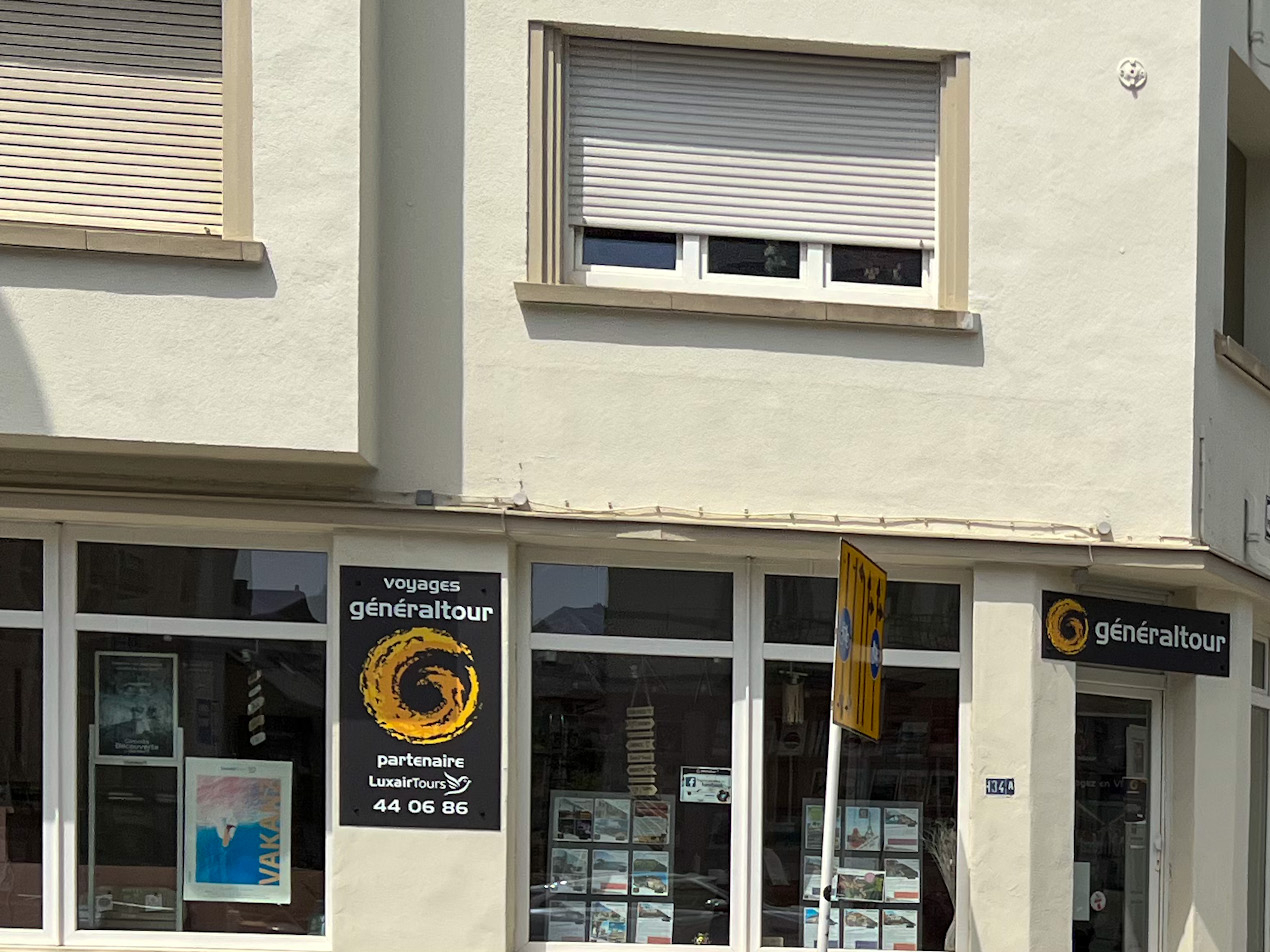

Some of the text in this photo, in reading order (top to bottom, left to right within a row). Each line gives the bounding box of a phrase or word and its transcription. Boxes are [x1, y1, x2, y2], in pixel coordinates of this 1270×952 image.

[384, 577, 460, 594] voyages
[349, 597, 493, 621] généraltour
[1095, 617, 1226, 653] généraltour
[377, 753, 464, 768] partenaire
[369, 775, 447, 789] LuxairTours
[373, 798, 469, 815] 44 06 86
